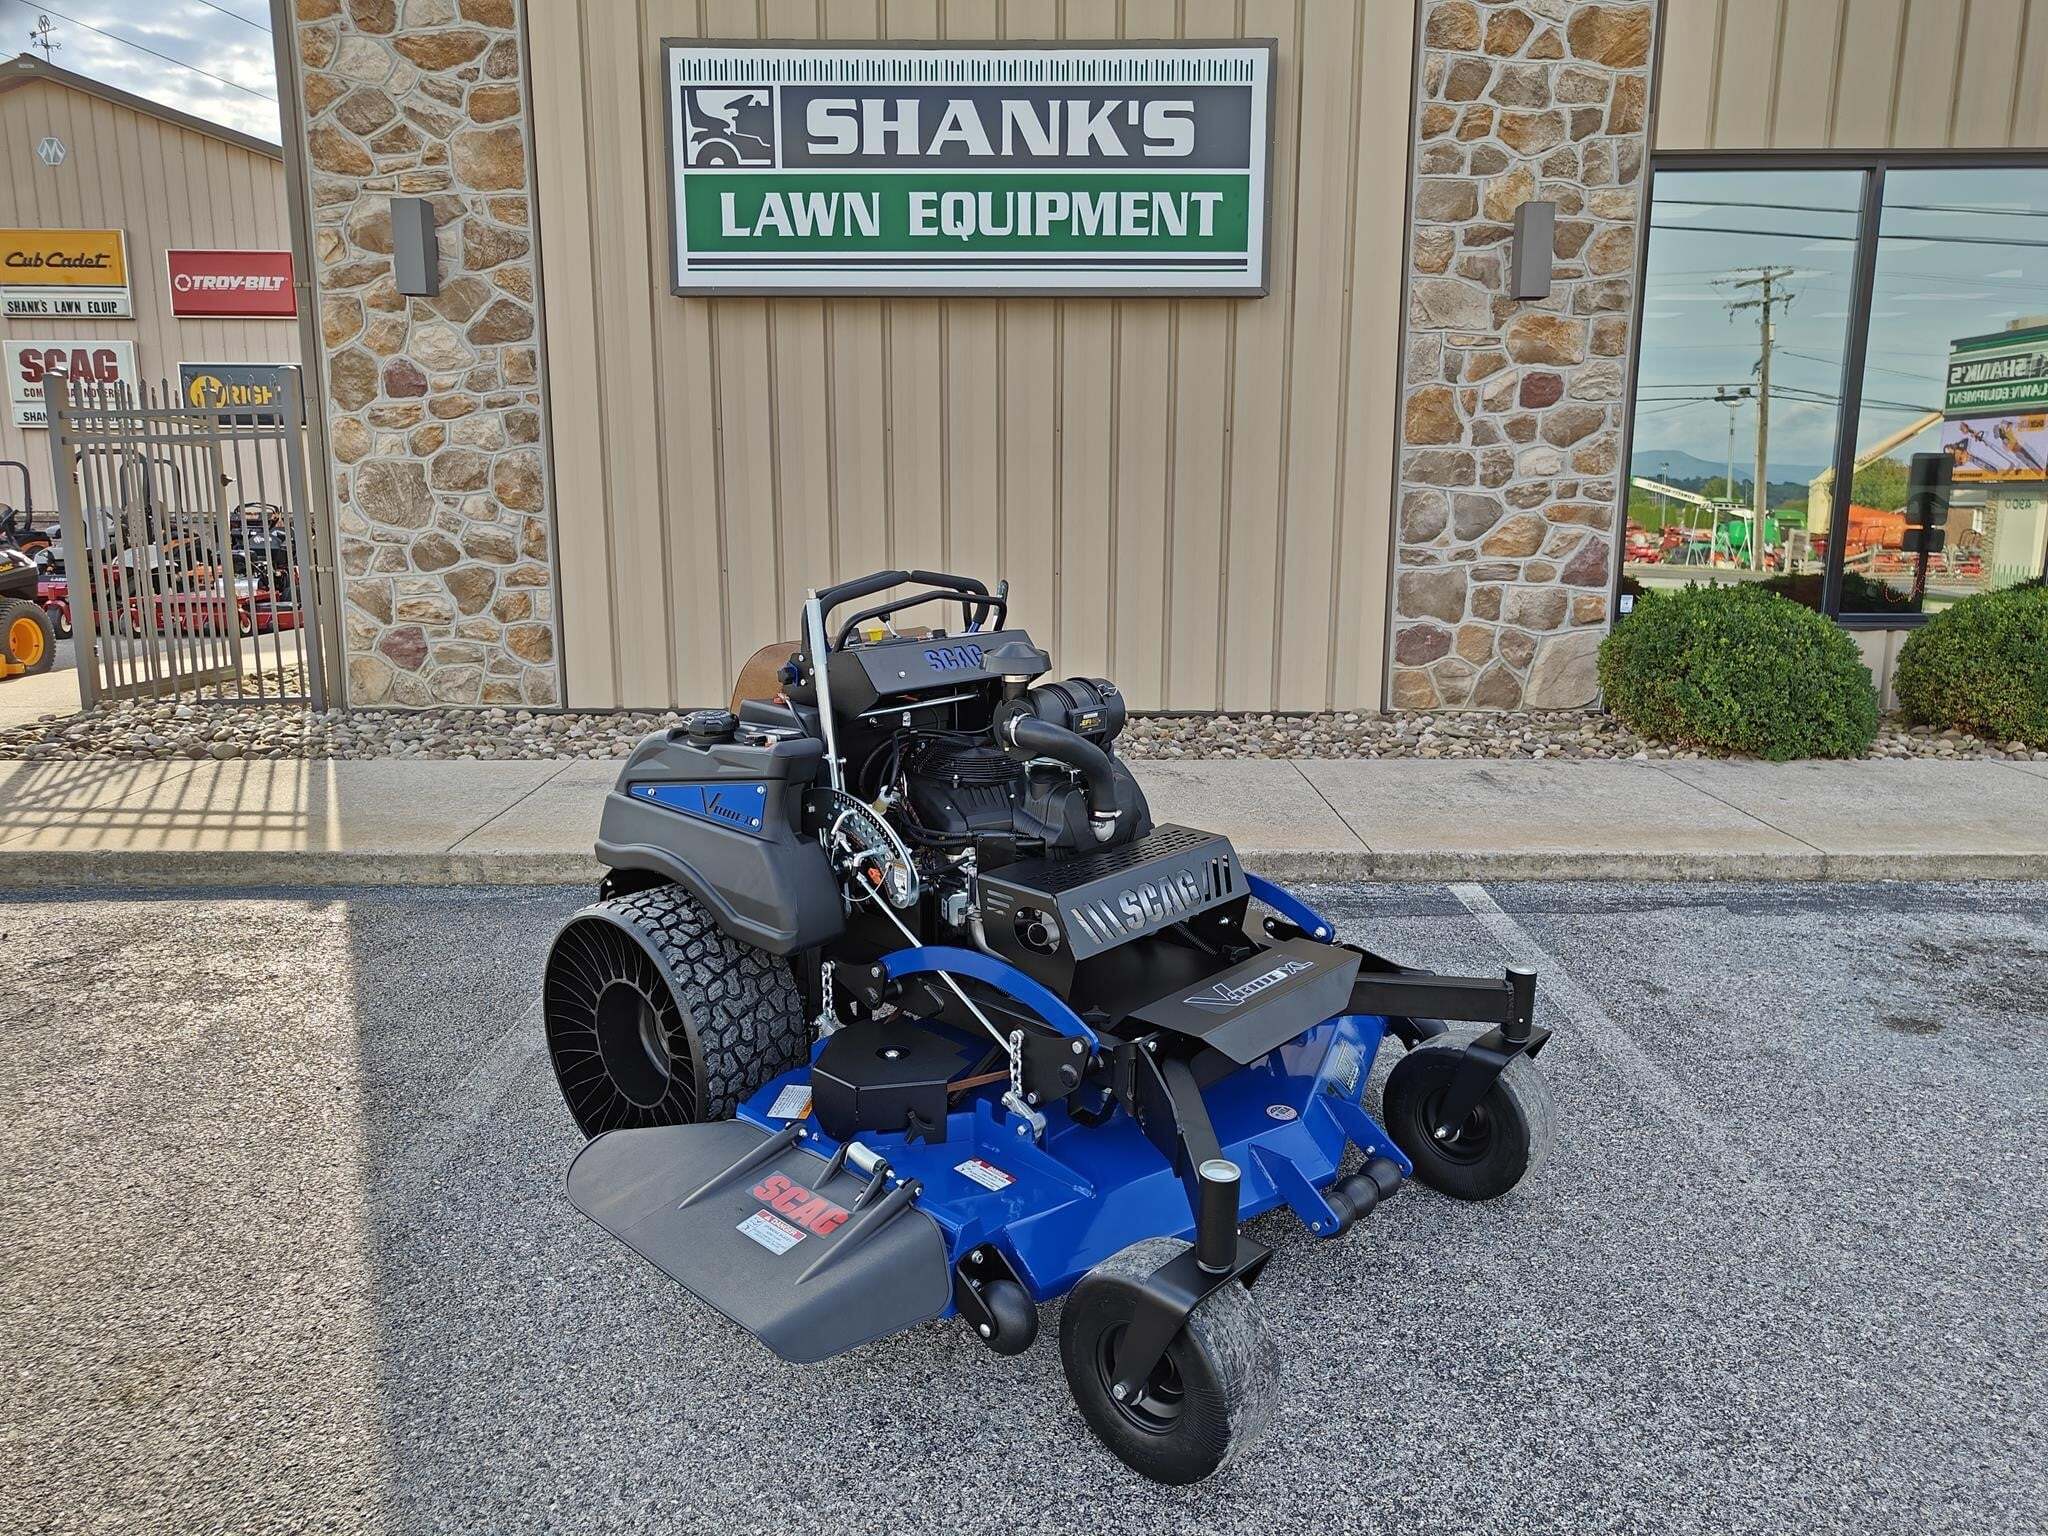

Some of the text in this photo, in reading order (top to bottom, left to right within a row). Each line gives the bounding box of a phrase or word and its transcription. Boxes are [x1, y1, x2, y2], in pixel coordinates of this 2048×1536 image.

[806, 98, 1196, 157] SHANK'S
[720, 190, 1223, 242] LAWN EQUIPMENT
[5, 252, 111, 269] Cub Cadet
[191, 275, 285, 291] TROY-BILT
[7, 299, 118, 313] SHANK'S LAWN EQUIP
[1118, 869, 1200, 930] SCAG
[753, 1175, 849, 1235] SCAG
